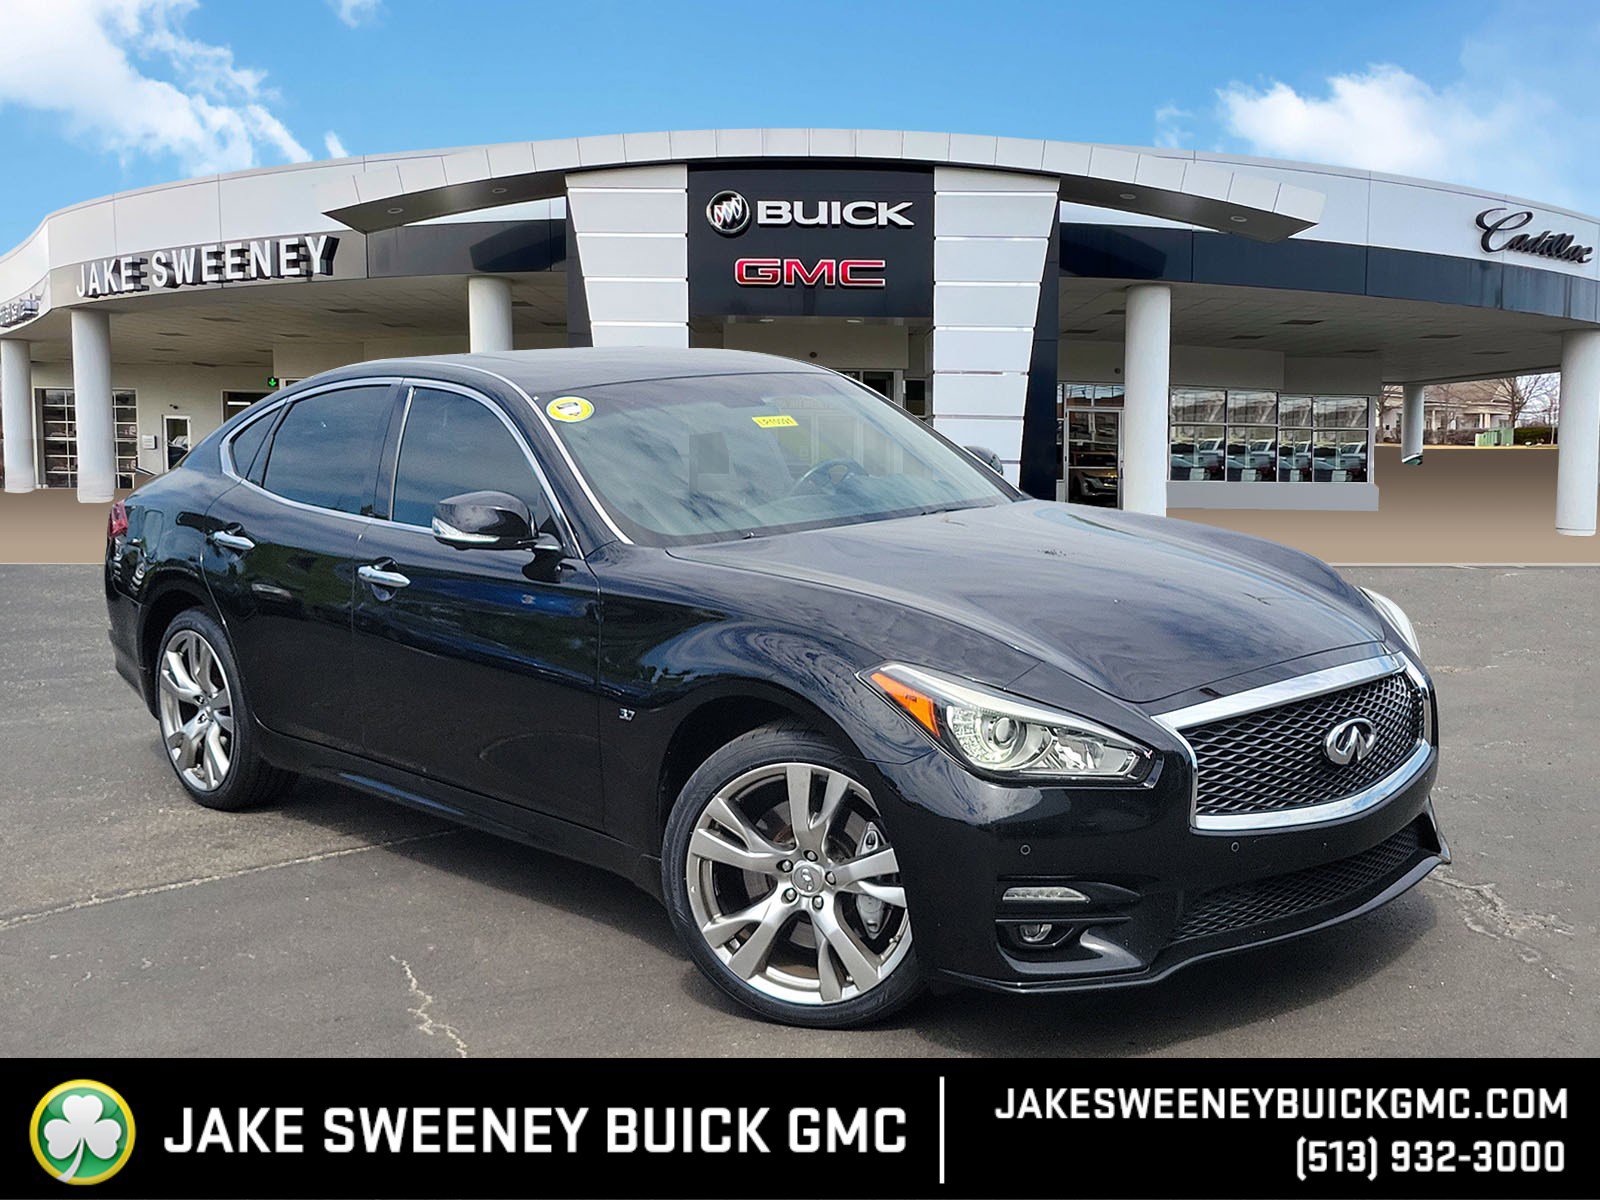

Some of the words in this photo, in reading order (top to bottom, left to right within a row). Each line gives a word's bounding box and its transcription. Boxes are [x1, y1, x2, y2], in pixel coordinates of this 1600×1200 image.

[757, 200, 915, 226] BUICK
[1475, 207, 1593, 264] Cadillac
[76, 256, 142, 298] JAKE
[151, 234, 332, 289] SWEENEY
[734, 258, 886, 288] GMC
